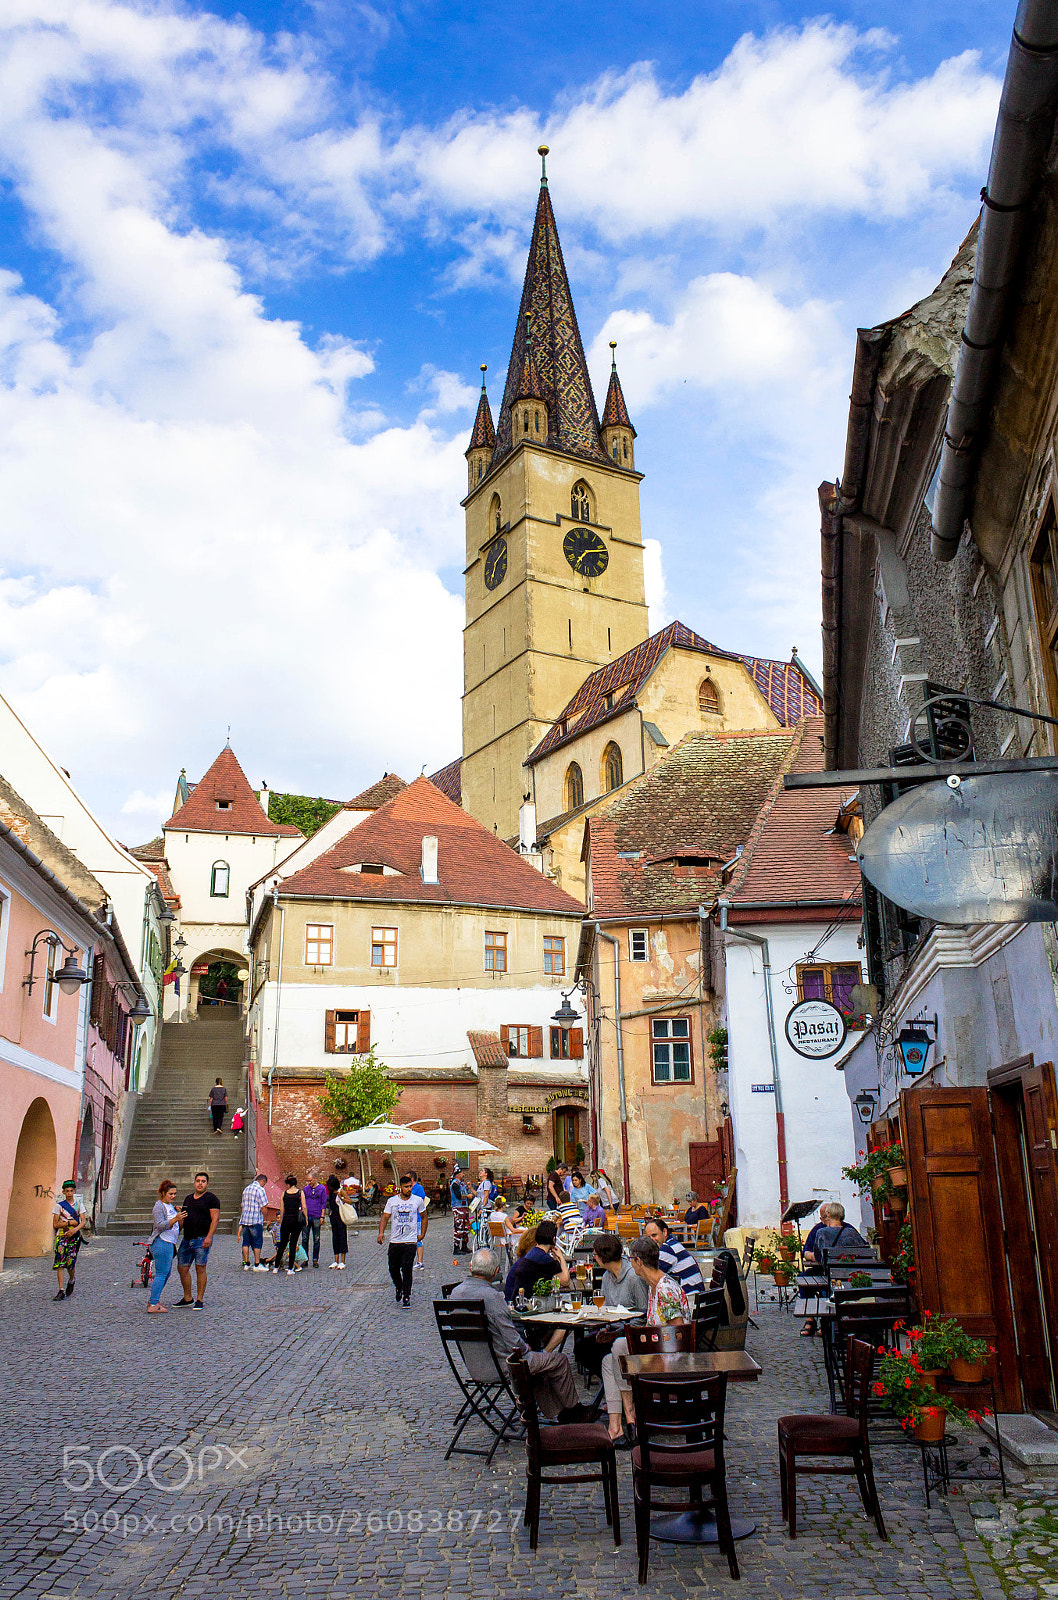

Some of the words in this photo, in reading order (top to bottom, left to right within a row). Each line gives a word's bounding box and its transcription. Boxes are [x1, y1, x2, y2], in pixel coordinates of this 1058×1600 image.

[793, 1018, 839, 1039] Pasaj
[798, 1037, 838, 1045] RESTAURANT
[508, 1103, 551, 1113] restaurant
